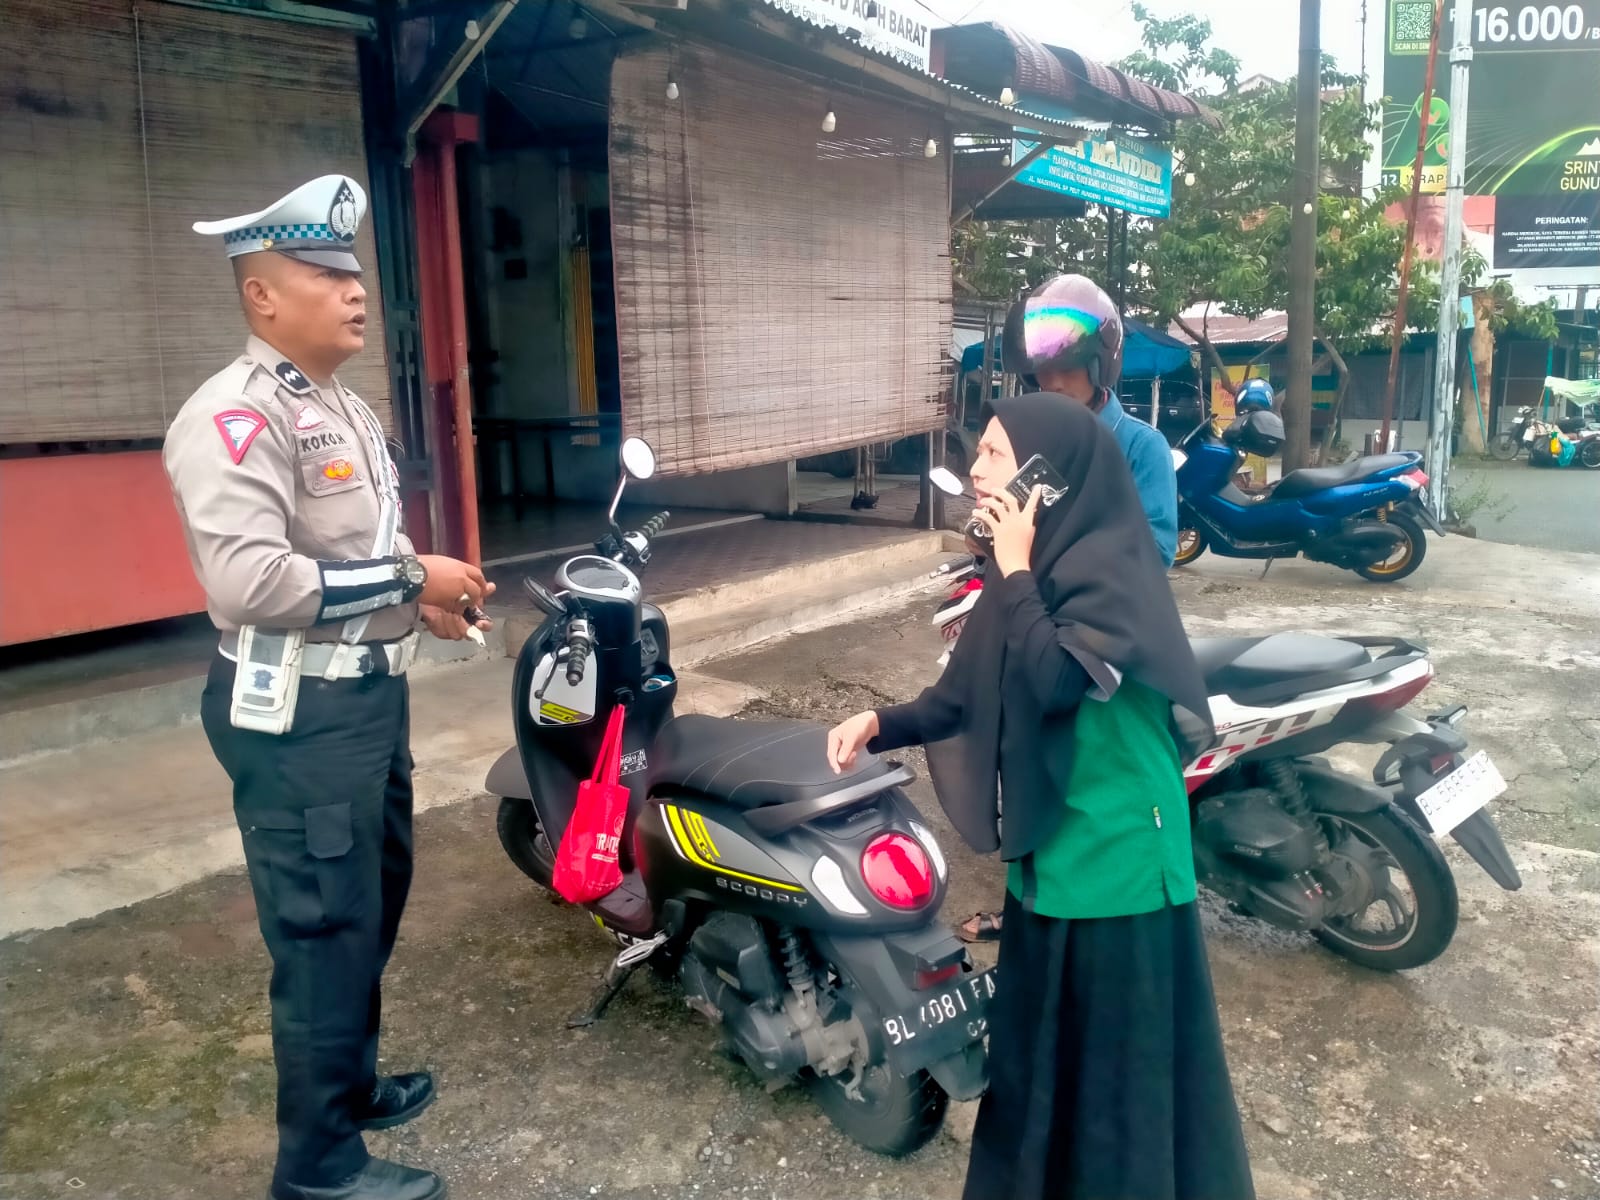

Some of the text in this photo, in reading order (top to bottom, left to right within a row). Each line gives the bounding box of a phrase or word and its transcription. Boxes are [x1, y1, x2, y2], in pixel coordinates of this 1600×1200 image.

[852, 0, 886, 30] ACH
[889, 9, 928, 48] BARAT
[1475, 5, 1584, 42] 16.000
[1535, 216, 1588, 225] PERINGATAN:
[715, 876, 808, 908] SCOOPY
[885, 1015, 916, 1045] BL
